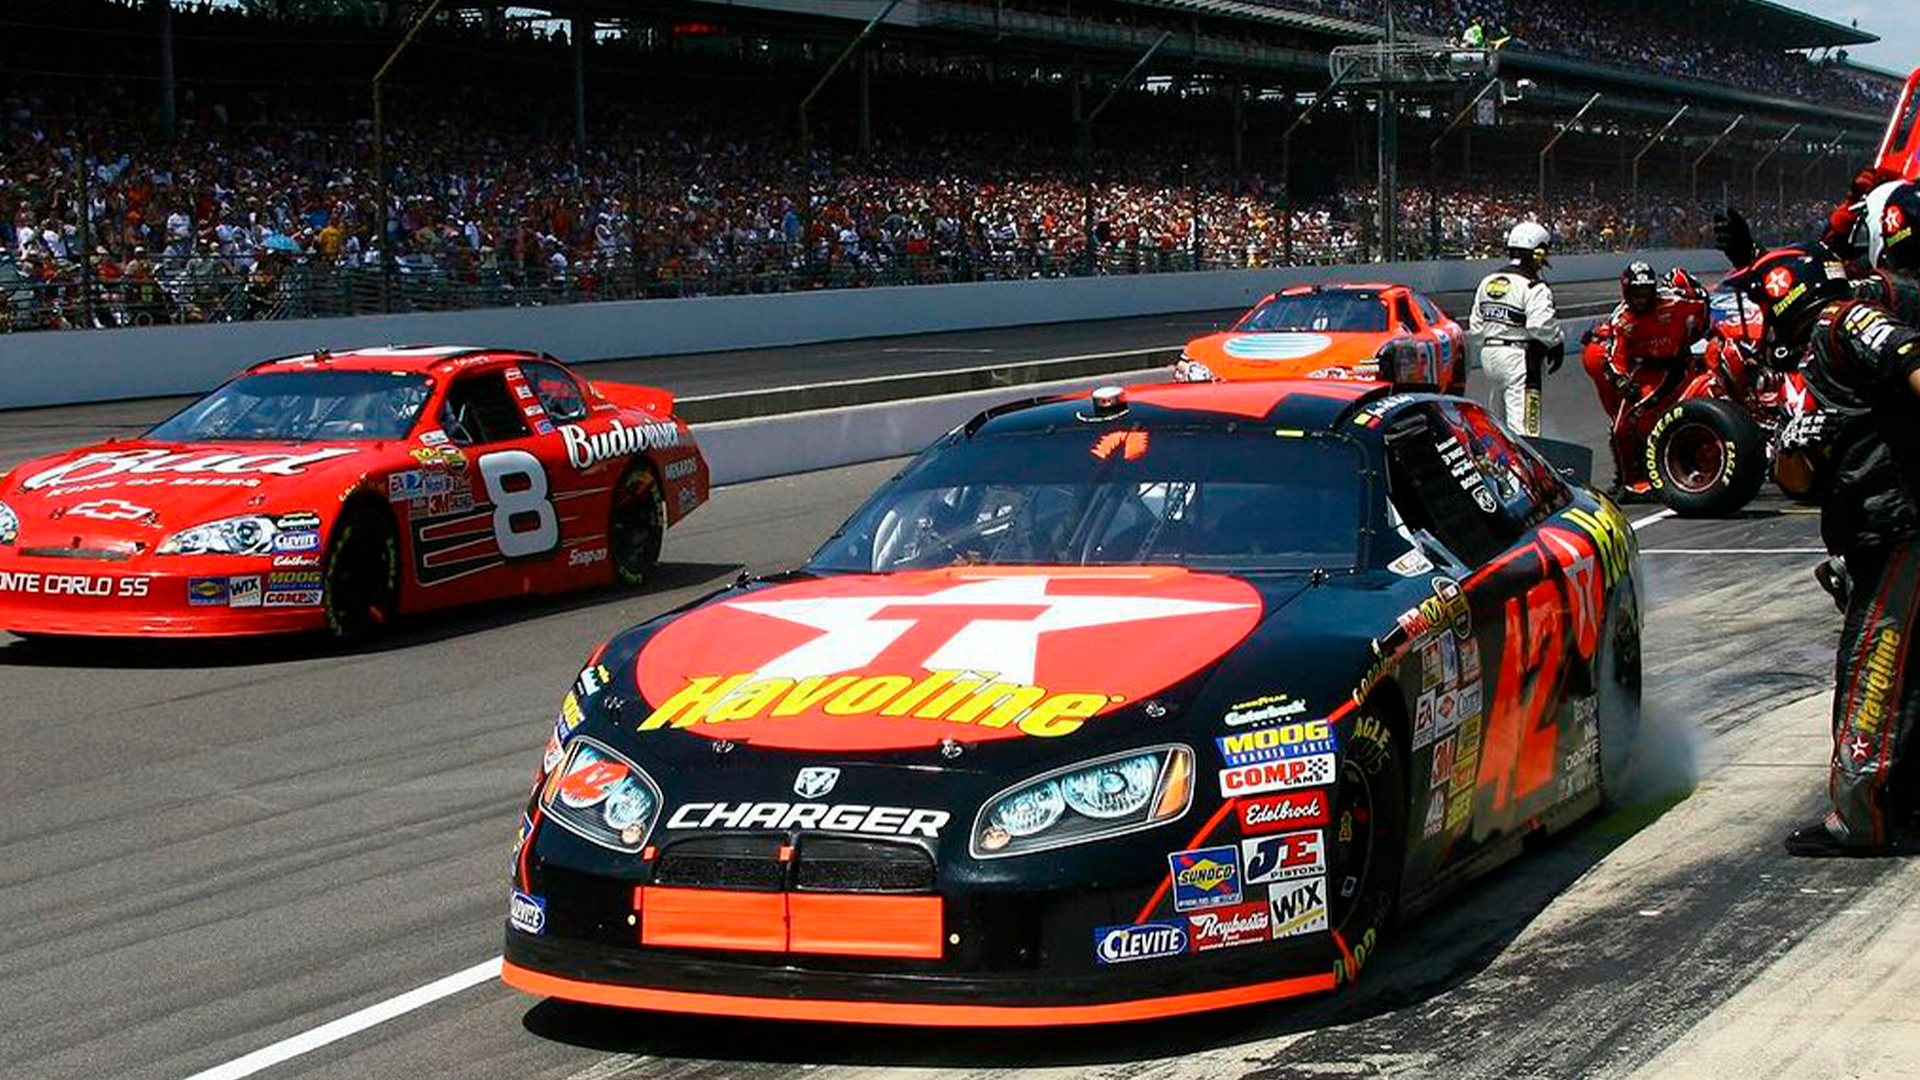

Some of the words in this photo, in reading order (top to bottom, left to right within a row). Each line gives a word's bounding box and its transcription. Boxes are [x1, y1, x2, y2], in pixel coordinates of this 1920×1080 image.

[1647, 405, 1684, 491] GOODYEAR
[1723, 441, 1736, 487] EAGLE
[20, 447, 363, 494] Bud
[478, 450, 559, 558] 8
[44, 575, 112, 596] CARLO
[118, 577, 150, 597] SS
[230, 576, 259, 595] WIX
[1477, 578, 1564, 812] 42
[1855, 626, 1901, 734] Havoline
[637, 668, 1112, 738] Havoline
[1223, 720, 1331, 756] MOOG
[1225, 760, 1307, 790] COMP
[1284, 773, 1324, 786] CAMS
[666, 803, 951, 838] CHARGER
[1245, 797, 1322, 826] Edelbrock
[1179, 865, 1235, 885] SUNOCO
[1248, 832, 1318, 882] JE
[1270, 864, 1325, 880] PISTONS
[1272, 880, 1324, 925] WIX
[1104, 928, 1180, 958] CLEVITE
